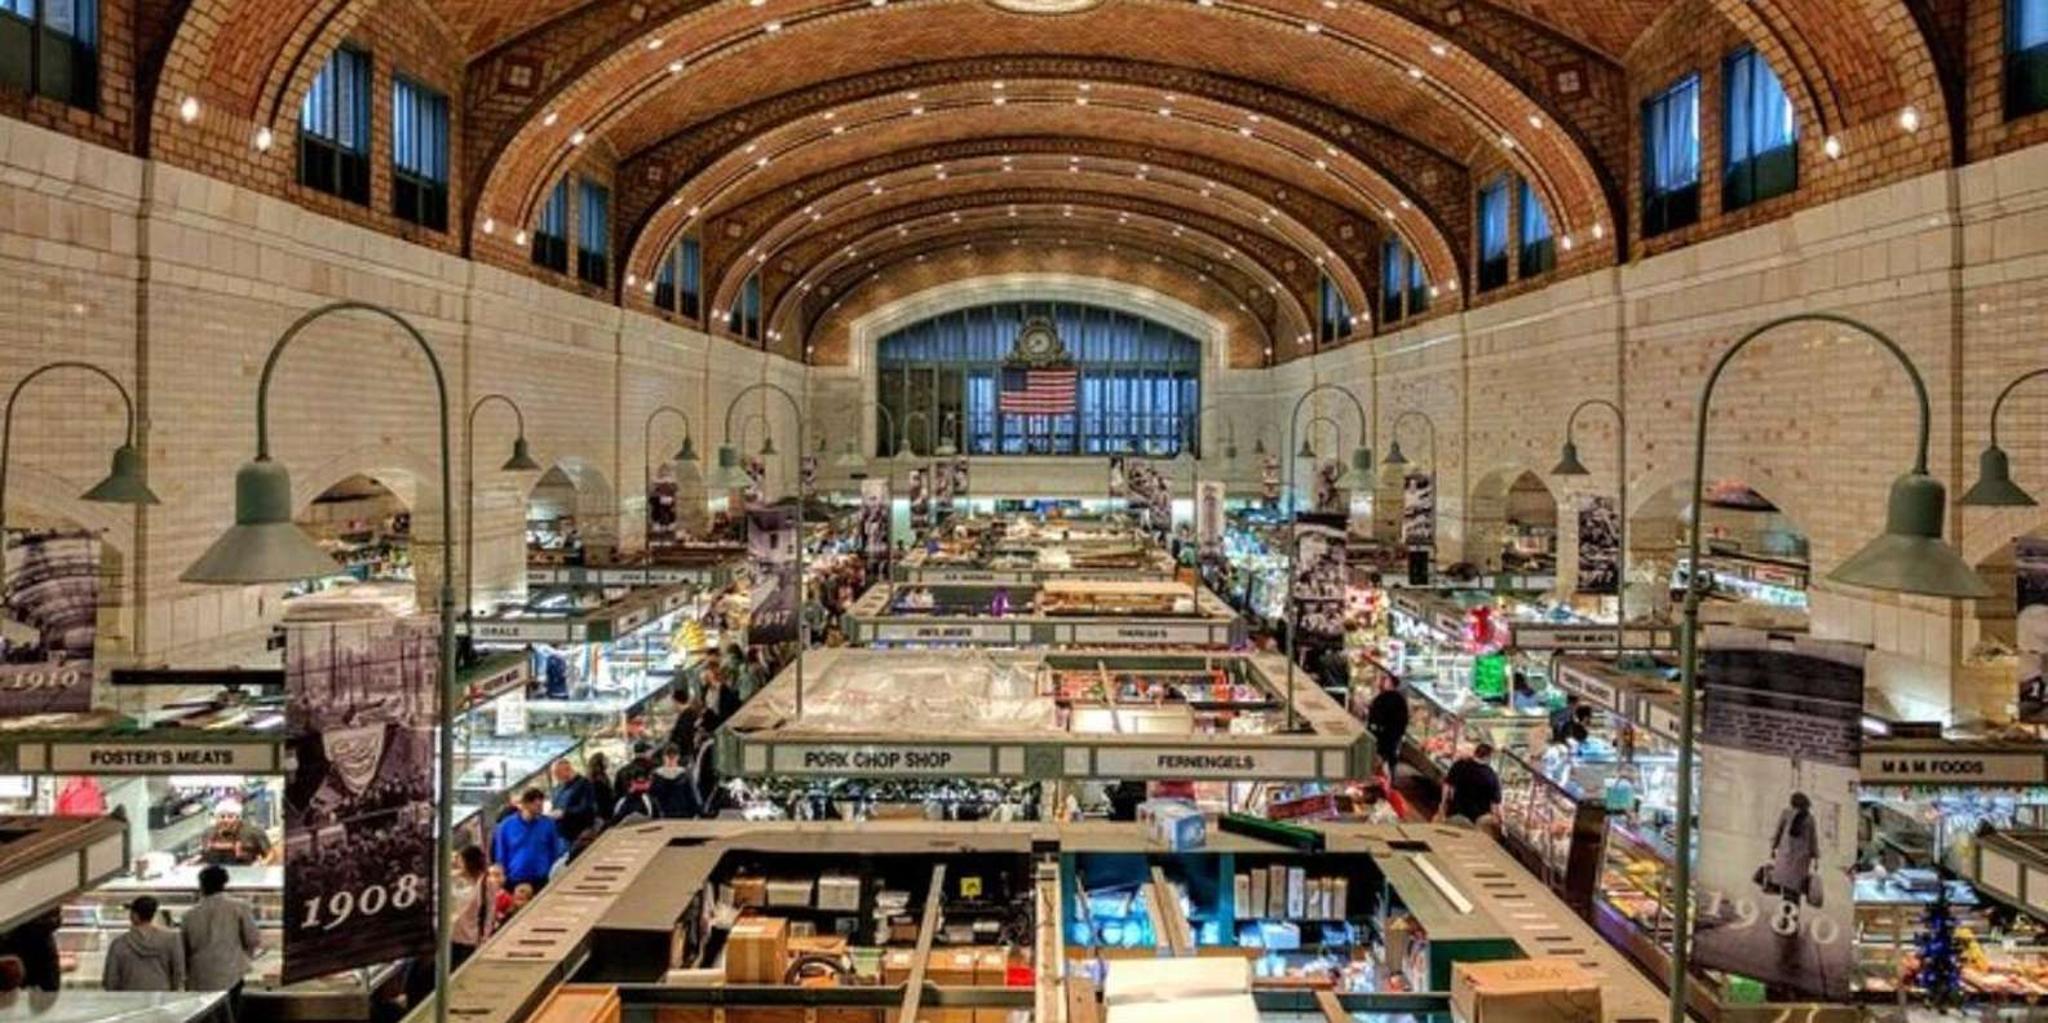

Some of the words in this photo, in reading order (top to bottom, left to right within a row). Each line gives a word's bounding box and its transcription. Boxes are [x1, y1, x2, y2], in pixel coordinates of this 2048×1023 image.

[12, 671, 79, 692] 1910
[90, 750, 173, 764] FOSTER'S
[176, 750, 233, 764] MEATS
[804, 751, 849, 767] PORK
[853, 752, 901, 767] CHOP
[904, 752, 951, 767] SHOP
[1882, 761, 1895, 773] M
[1898, 761, 1909, 773] &
[1913, 761, 1926, 773] M
[1930, 761, 1984, 774] FOODS
[300, 873, 418, 930] 1908
[1704, 890, 1838, 944] 1980
